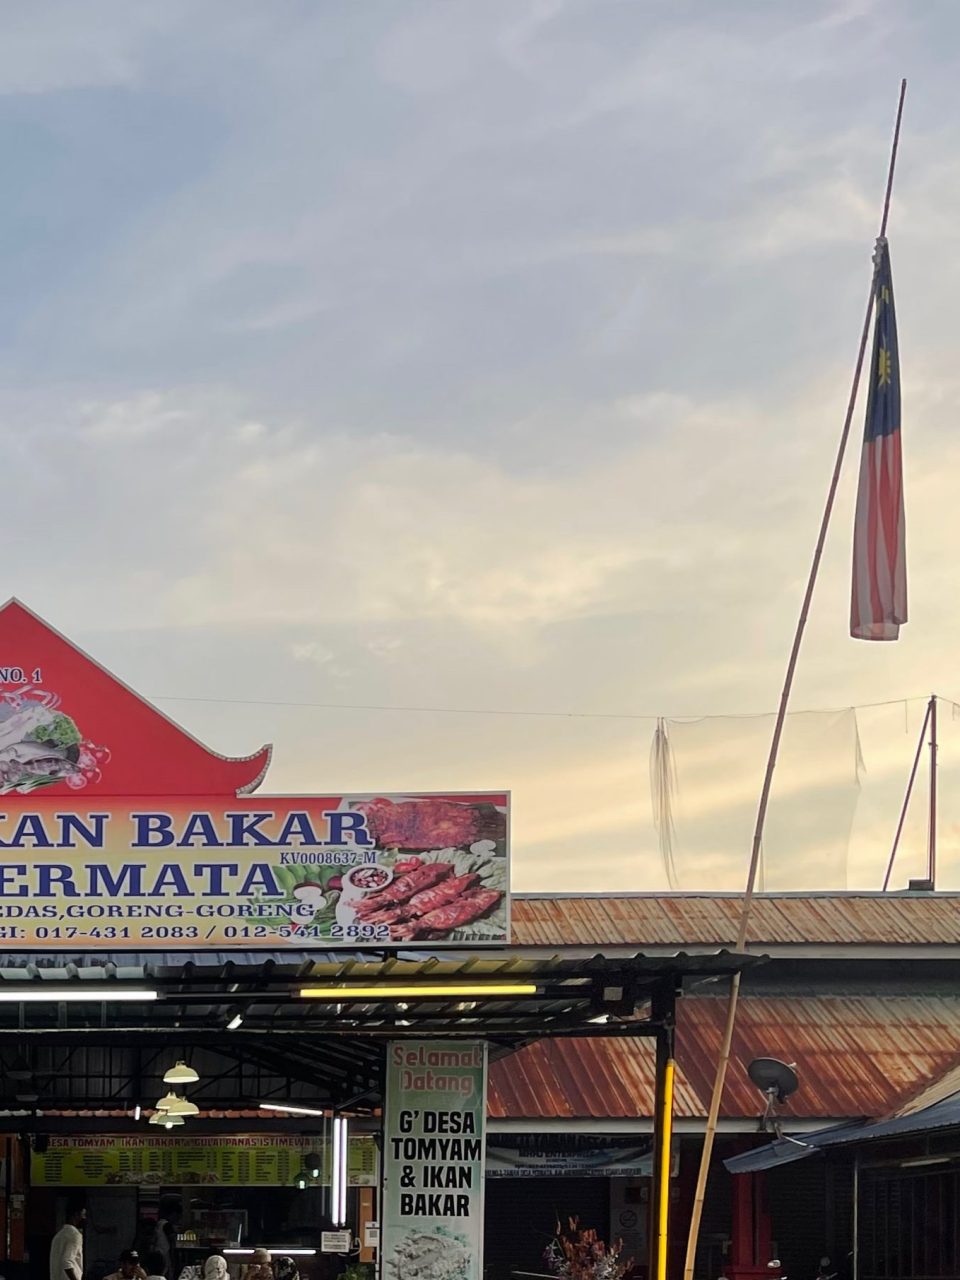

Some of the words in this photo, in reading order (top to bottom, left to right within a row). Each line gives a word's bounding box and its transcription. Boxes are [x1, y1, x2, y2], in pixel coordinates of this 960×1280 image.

[33, 668, 42, 682] 1
[131, 812, 373, 847] BAKAR
[279, 851, 377, 865] KV0008637-M
[35, 926, 131, 939] 017-431
[140, 926, 199, 938] 2083
[206, 925, 217, 939] /
[223, 925, 321, 938] 012-541
[331, 925, 390, 938] 2892
[393, 1045, 480, 1067] Selamat
[391, 1137, 481, 1160] TOMYAM
[400, 1165, 416, 1188] &
[423, 1165, 472, 1188] IKAN
[400, 1193, 470, 1217] BAKAR
